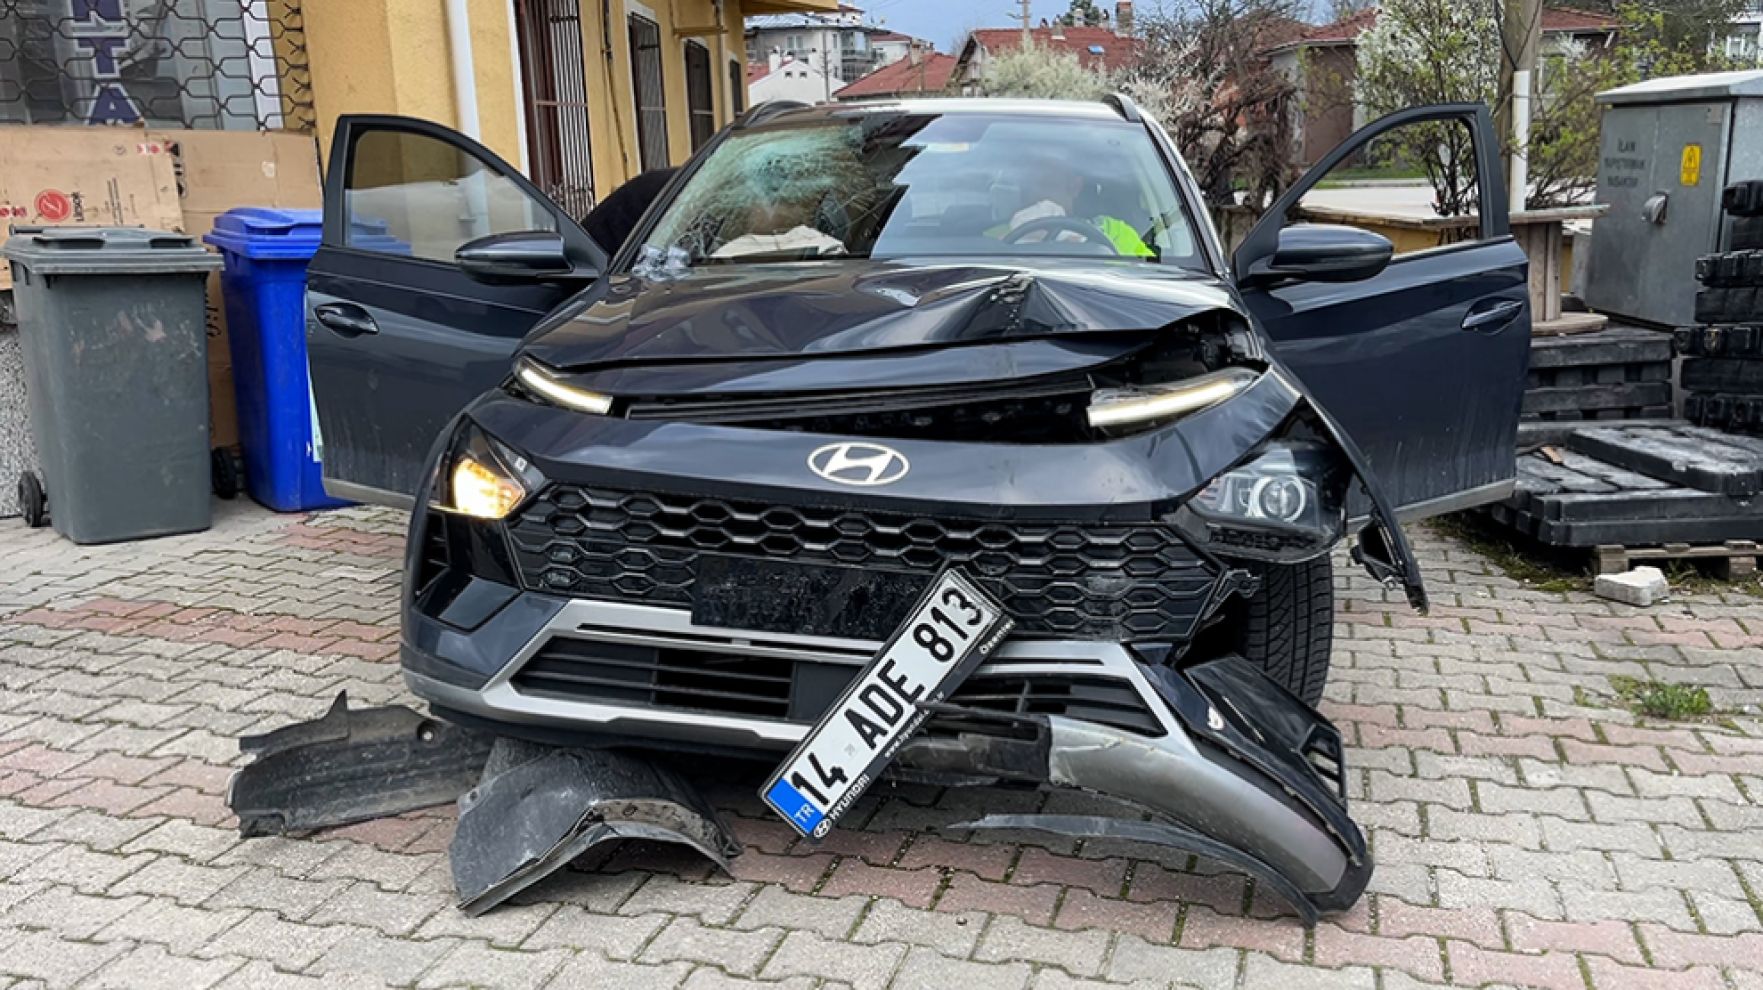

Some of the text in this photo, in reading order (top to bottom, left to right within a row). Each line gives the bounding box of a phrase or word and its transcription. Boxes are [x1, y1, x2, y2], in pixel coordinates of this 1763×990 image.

[791, 587, 983, 806] 14 ADE 813
[793, 803, 815, 823] TR
[829, 773, 870, 820] HYUNDAI
